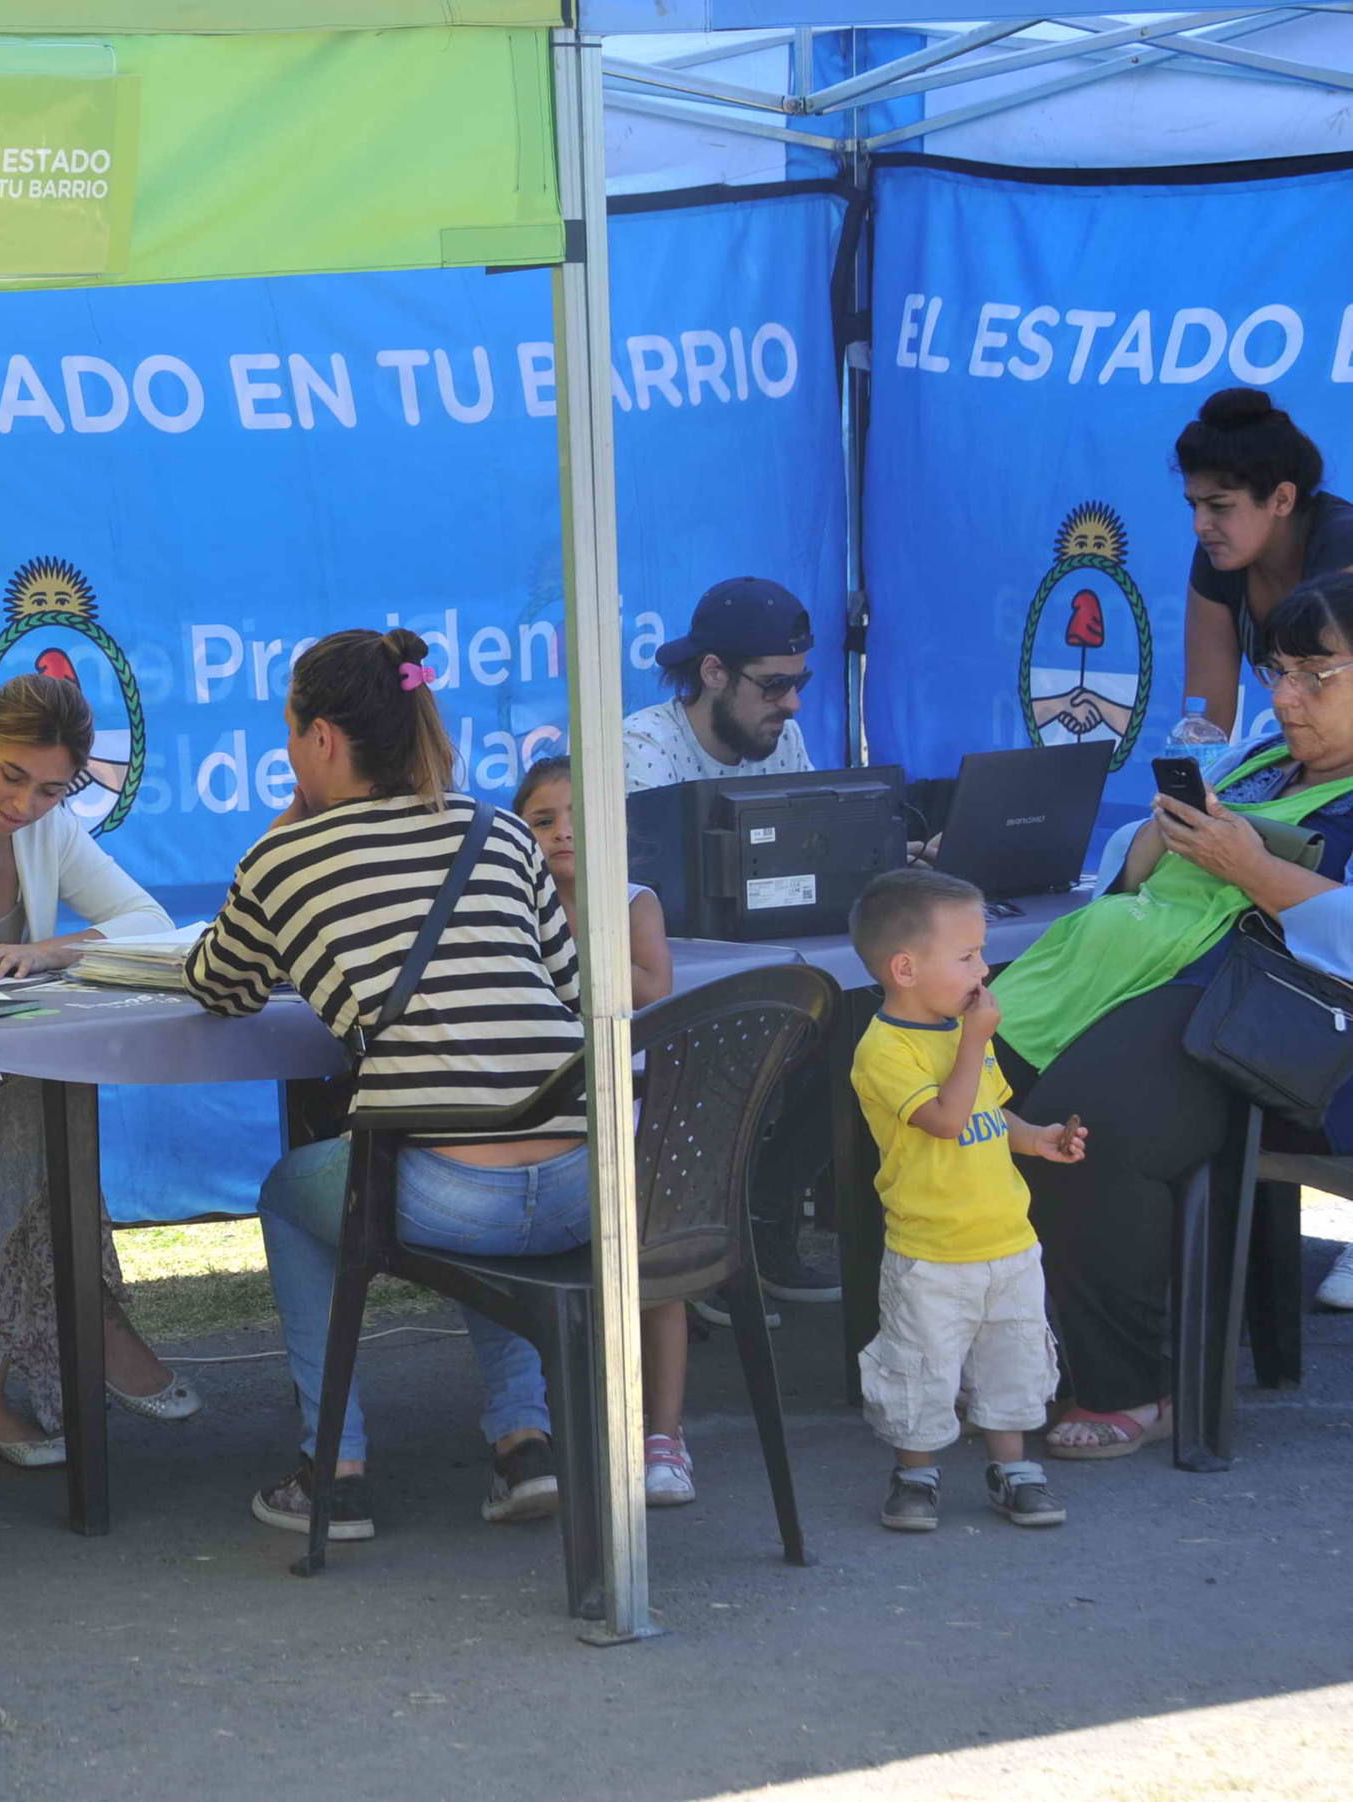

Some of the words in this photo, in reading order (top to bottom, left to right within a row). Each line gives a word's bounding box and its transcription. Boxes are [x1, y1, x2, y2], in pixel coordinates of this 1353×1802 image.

[3, 148, 111, 173] ESTADO
[29, 179, 109, 199] BARRIO
[896, 293, 950, 373] EL
[968, 303, 1304, 385] ESTADO
[229, 352, 358, 429] EN
[376, 345, 495, 425] TU
[197, 729, 299, 813] de
